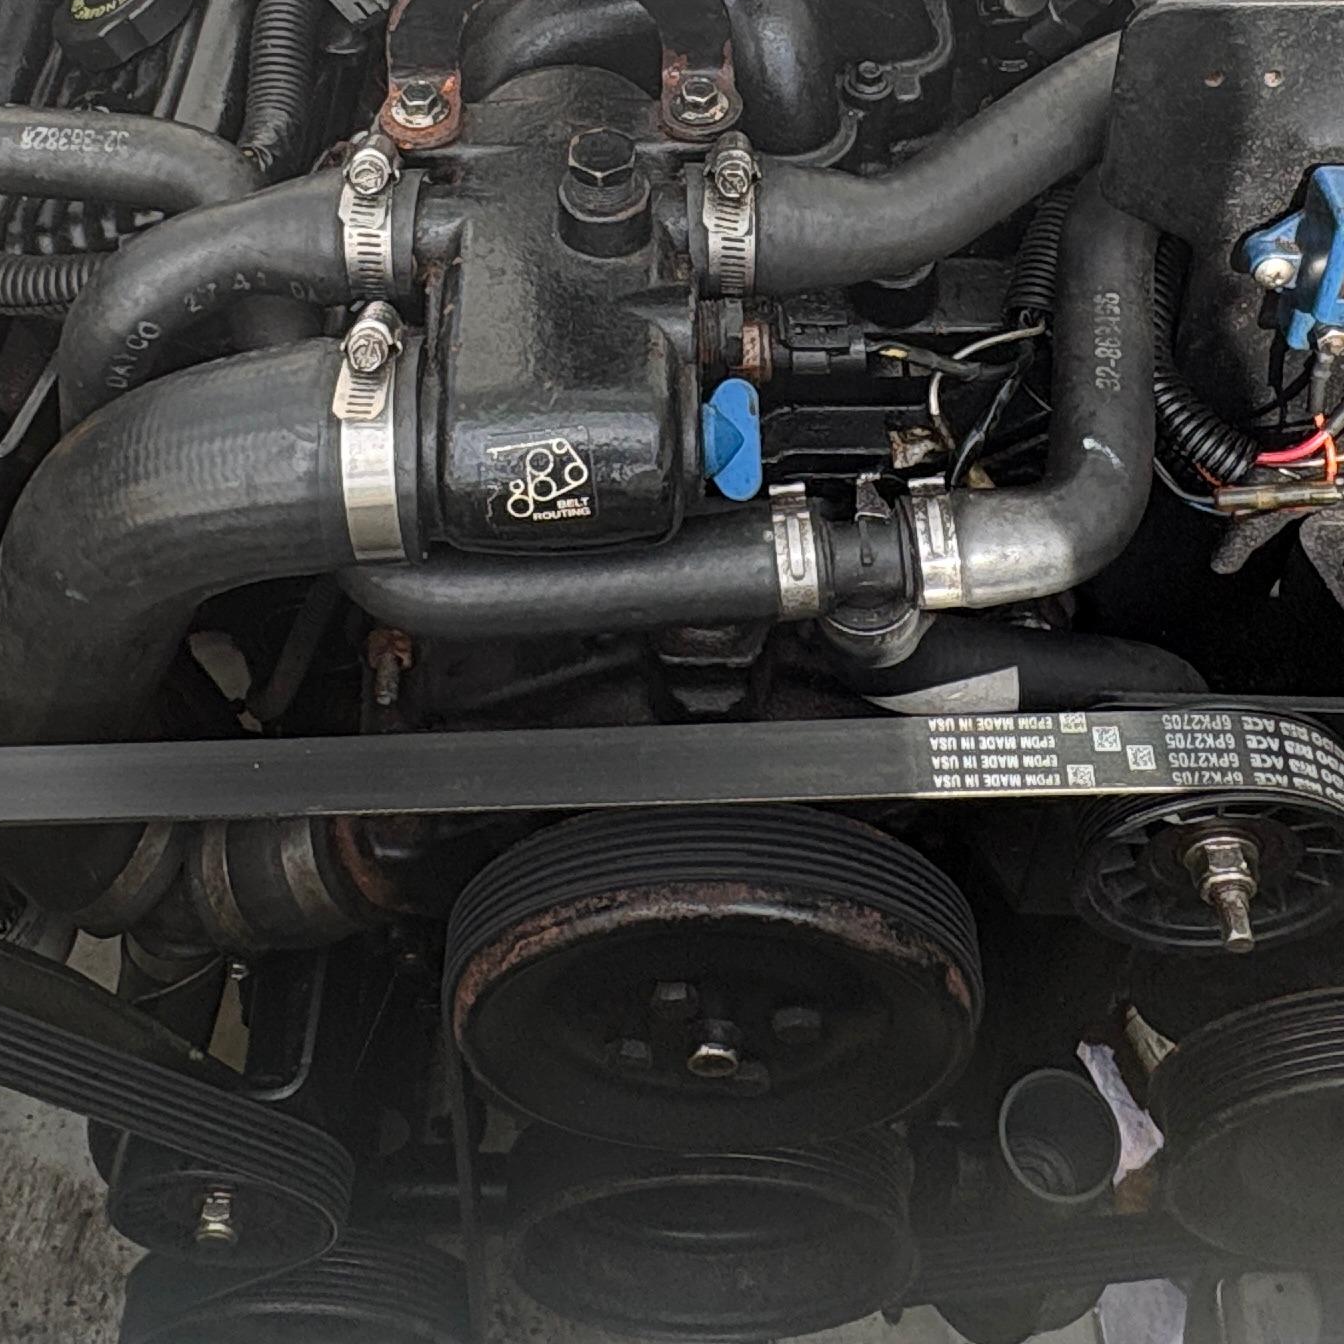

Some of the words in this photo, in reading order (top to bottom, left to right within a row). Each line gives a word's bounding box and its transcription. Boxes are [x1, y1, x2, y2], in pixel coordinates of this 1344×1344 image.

[556, 496, 590, 509] BELT
[533, 507, 591, 521] ROUTING
[928, 718, 955, 732] USA
[958, 717, 973, 731] IN
[976, 716, 1014, 731] MADE
[1018, 716, 1053, 730] EPDM
[1162, 714, 1232, 730] 6PK2705
[1241, 715, 1275, 733] ACE
[929, 736, 957, 751] USA
[961, 736, 976, 750] IN
[978, 736, 1017, 750] MADE
[1020, 735, 1056, 749] EPDM
[1164, 732, 1236, 749] 6PK2705
[1245, 734, 1280, 751] ACE
[931, 755, 960, 770] USA
[962, 755, 978, 769] IN
[980, 754, 1020, 769] MADE
[1022, 754, 1058, 768] EPDM
[1168, 752, 1240, 769] 6PK2705
[1250, 753, 1284, 770] ACE
[932, 774, 961, 788] USA
[964, 774, 980, 788] IN
[982, 773, 1022, 787] MADE
[1025, 773, 1061, 786] EPDM
[1172, 771, 1244, 785] 6PK2705
[1253, 772, 1289, 788] ACE
